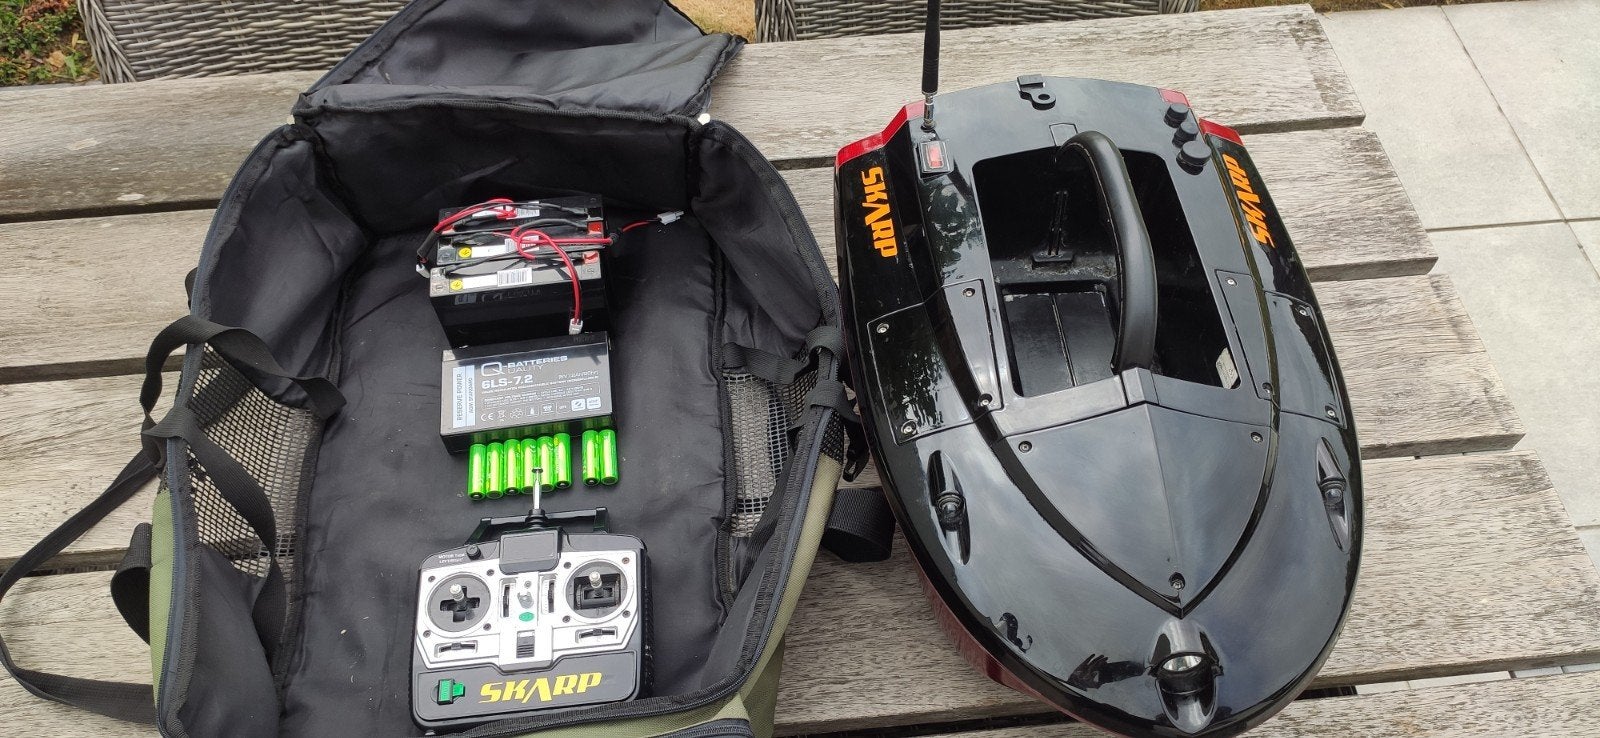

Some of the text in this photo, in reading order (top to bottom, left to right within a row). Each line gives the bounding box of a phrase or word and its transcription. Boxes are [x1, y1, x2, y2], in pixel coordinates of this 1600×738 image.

[861, 166, 898, 258] SKARP
[1222, 153, 1276, 249] SKARP
[481, 375, 533, 389] 6LS-7.2
[478, 672, 602, 704] SKARP
